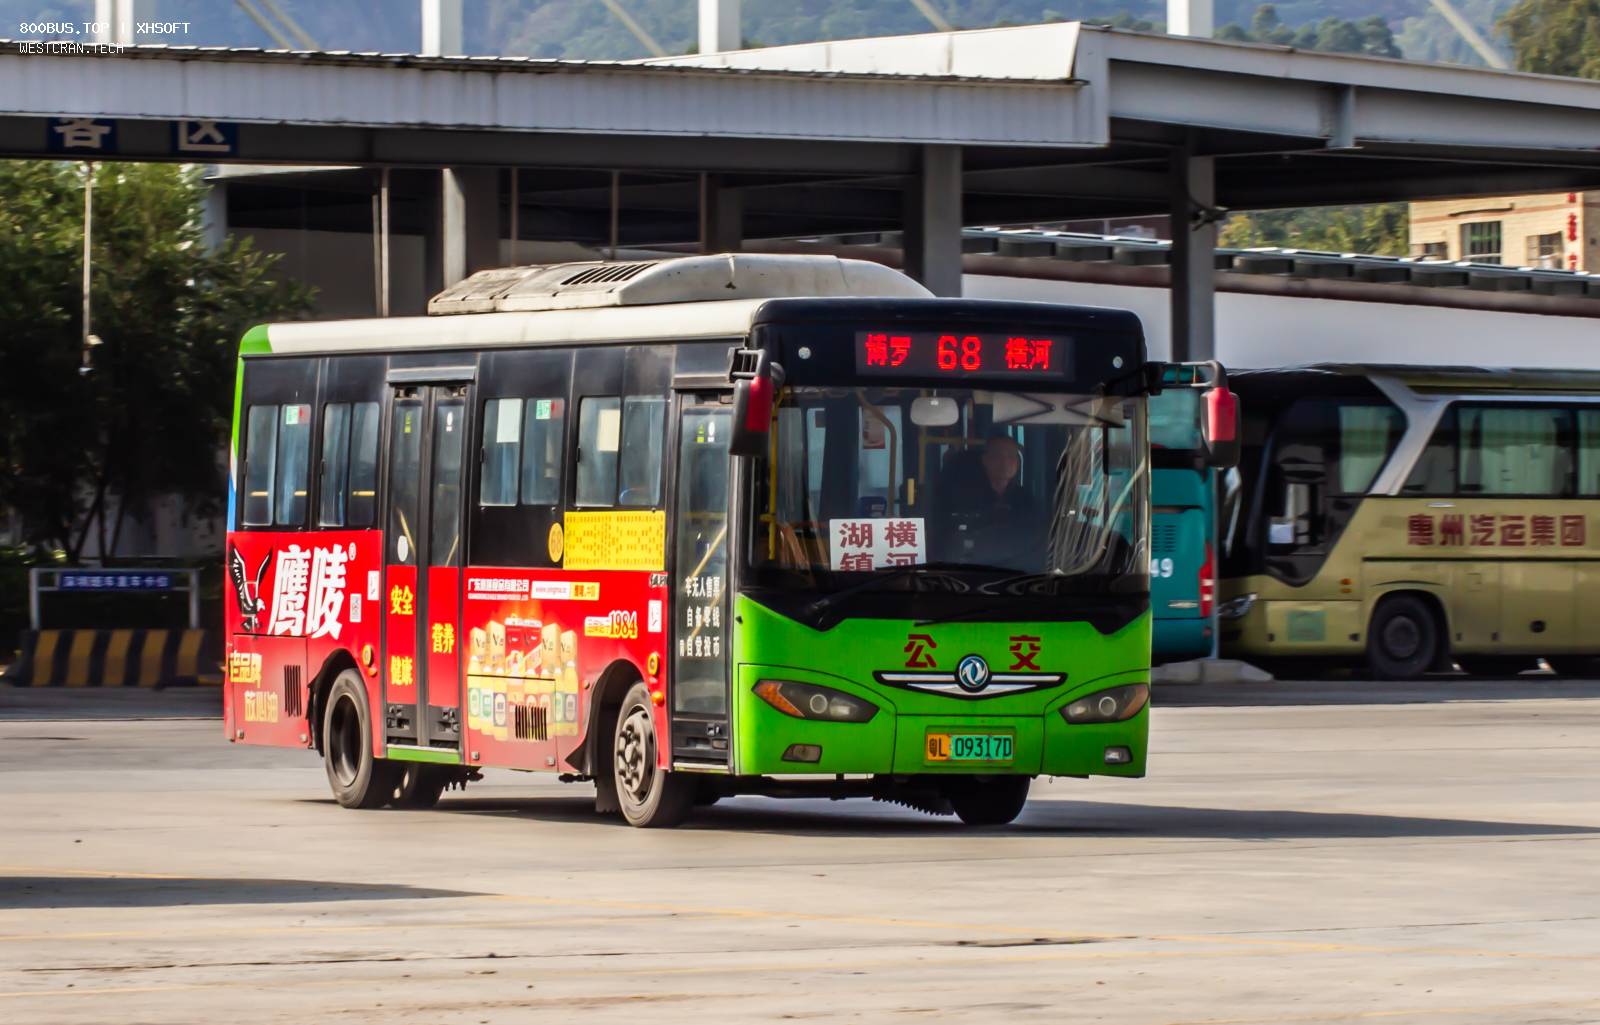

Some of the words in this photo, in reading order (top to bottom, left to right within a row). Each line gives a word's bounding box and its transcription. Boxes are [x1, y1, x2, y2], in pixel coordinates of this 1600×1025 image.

[865, 334, 911, 366] 博罗
[937, 335, 981, 370] 68
[1005, 337, 1053, 370] 横河
[1407, 514, 1586, 546] 惠州汽运集团
[390, 585, 414, 614] 安全
[432, 623, 455, 653] 营养
[610, 612, 637, 636] 1984
[904, 634, 1041, 670] 公交
[955, 738, 1012, 757] 09317D
